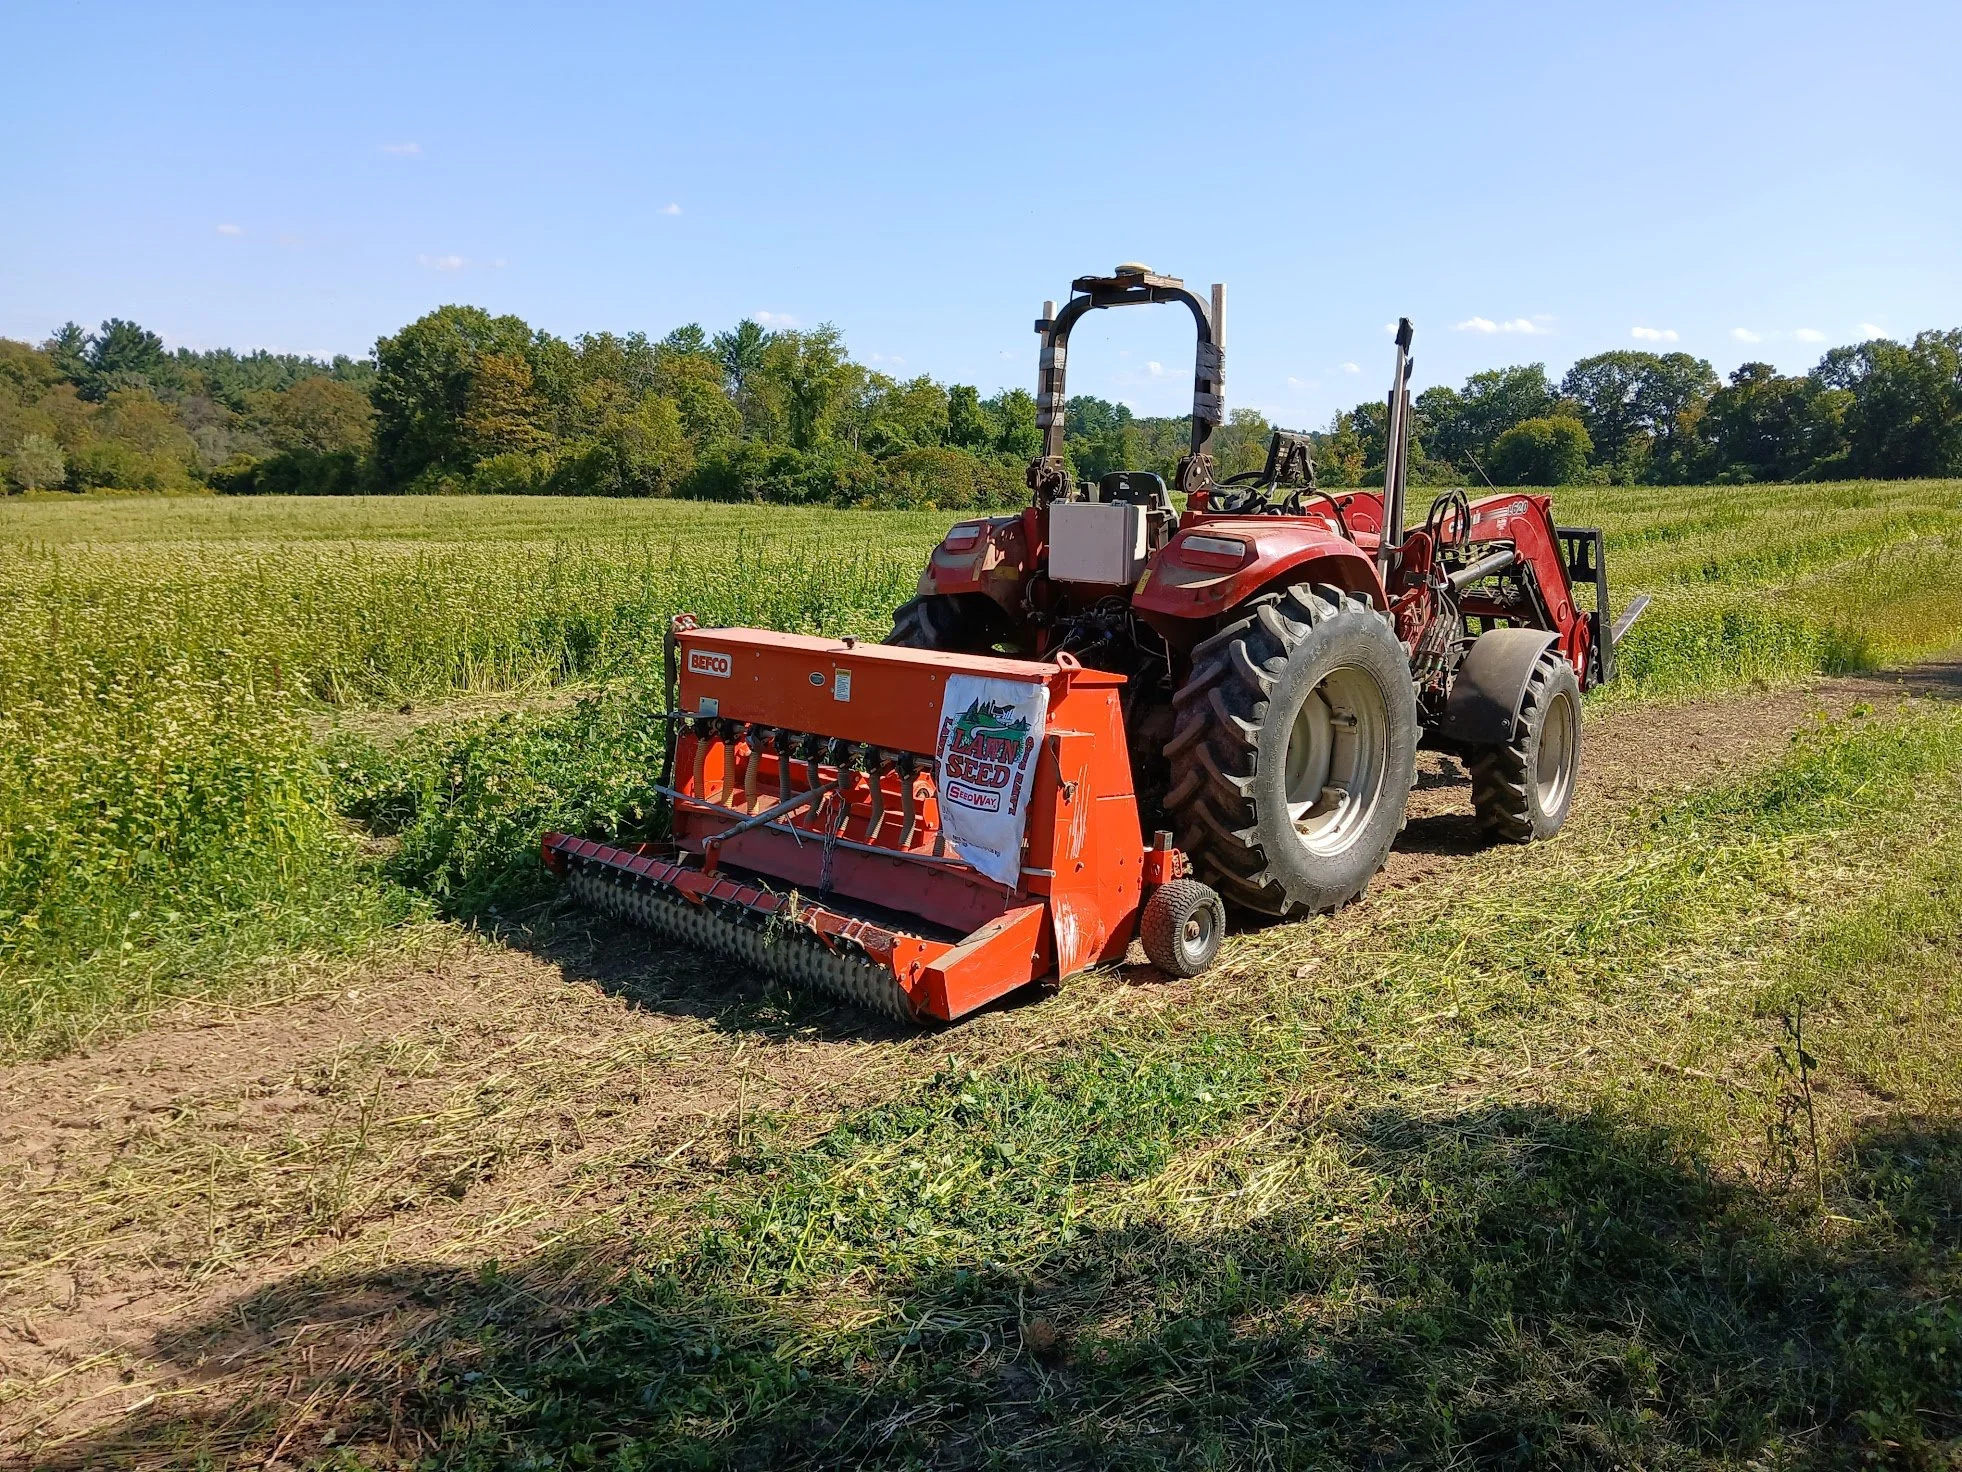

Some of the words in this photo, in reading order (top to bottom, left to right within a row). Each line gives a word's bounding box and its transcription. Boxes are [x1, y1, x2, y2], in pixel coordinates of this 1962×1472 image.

[691, 654, 728, 673] BEFCO
[950, 728, 1020, 765] LAWN
[945, 753, 1011, 788] SEED
